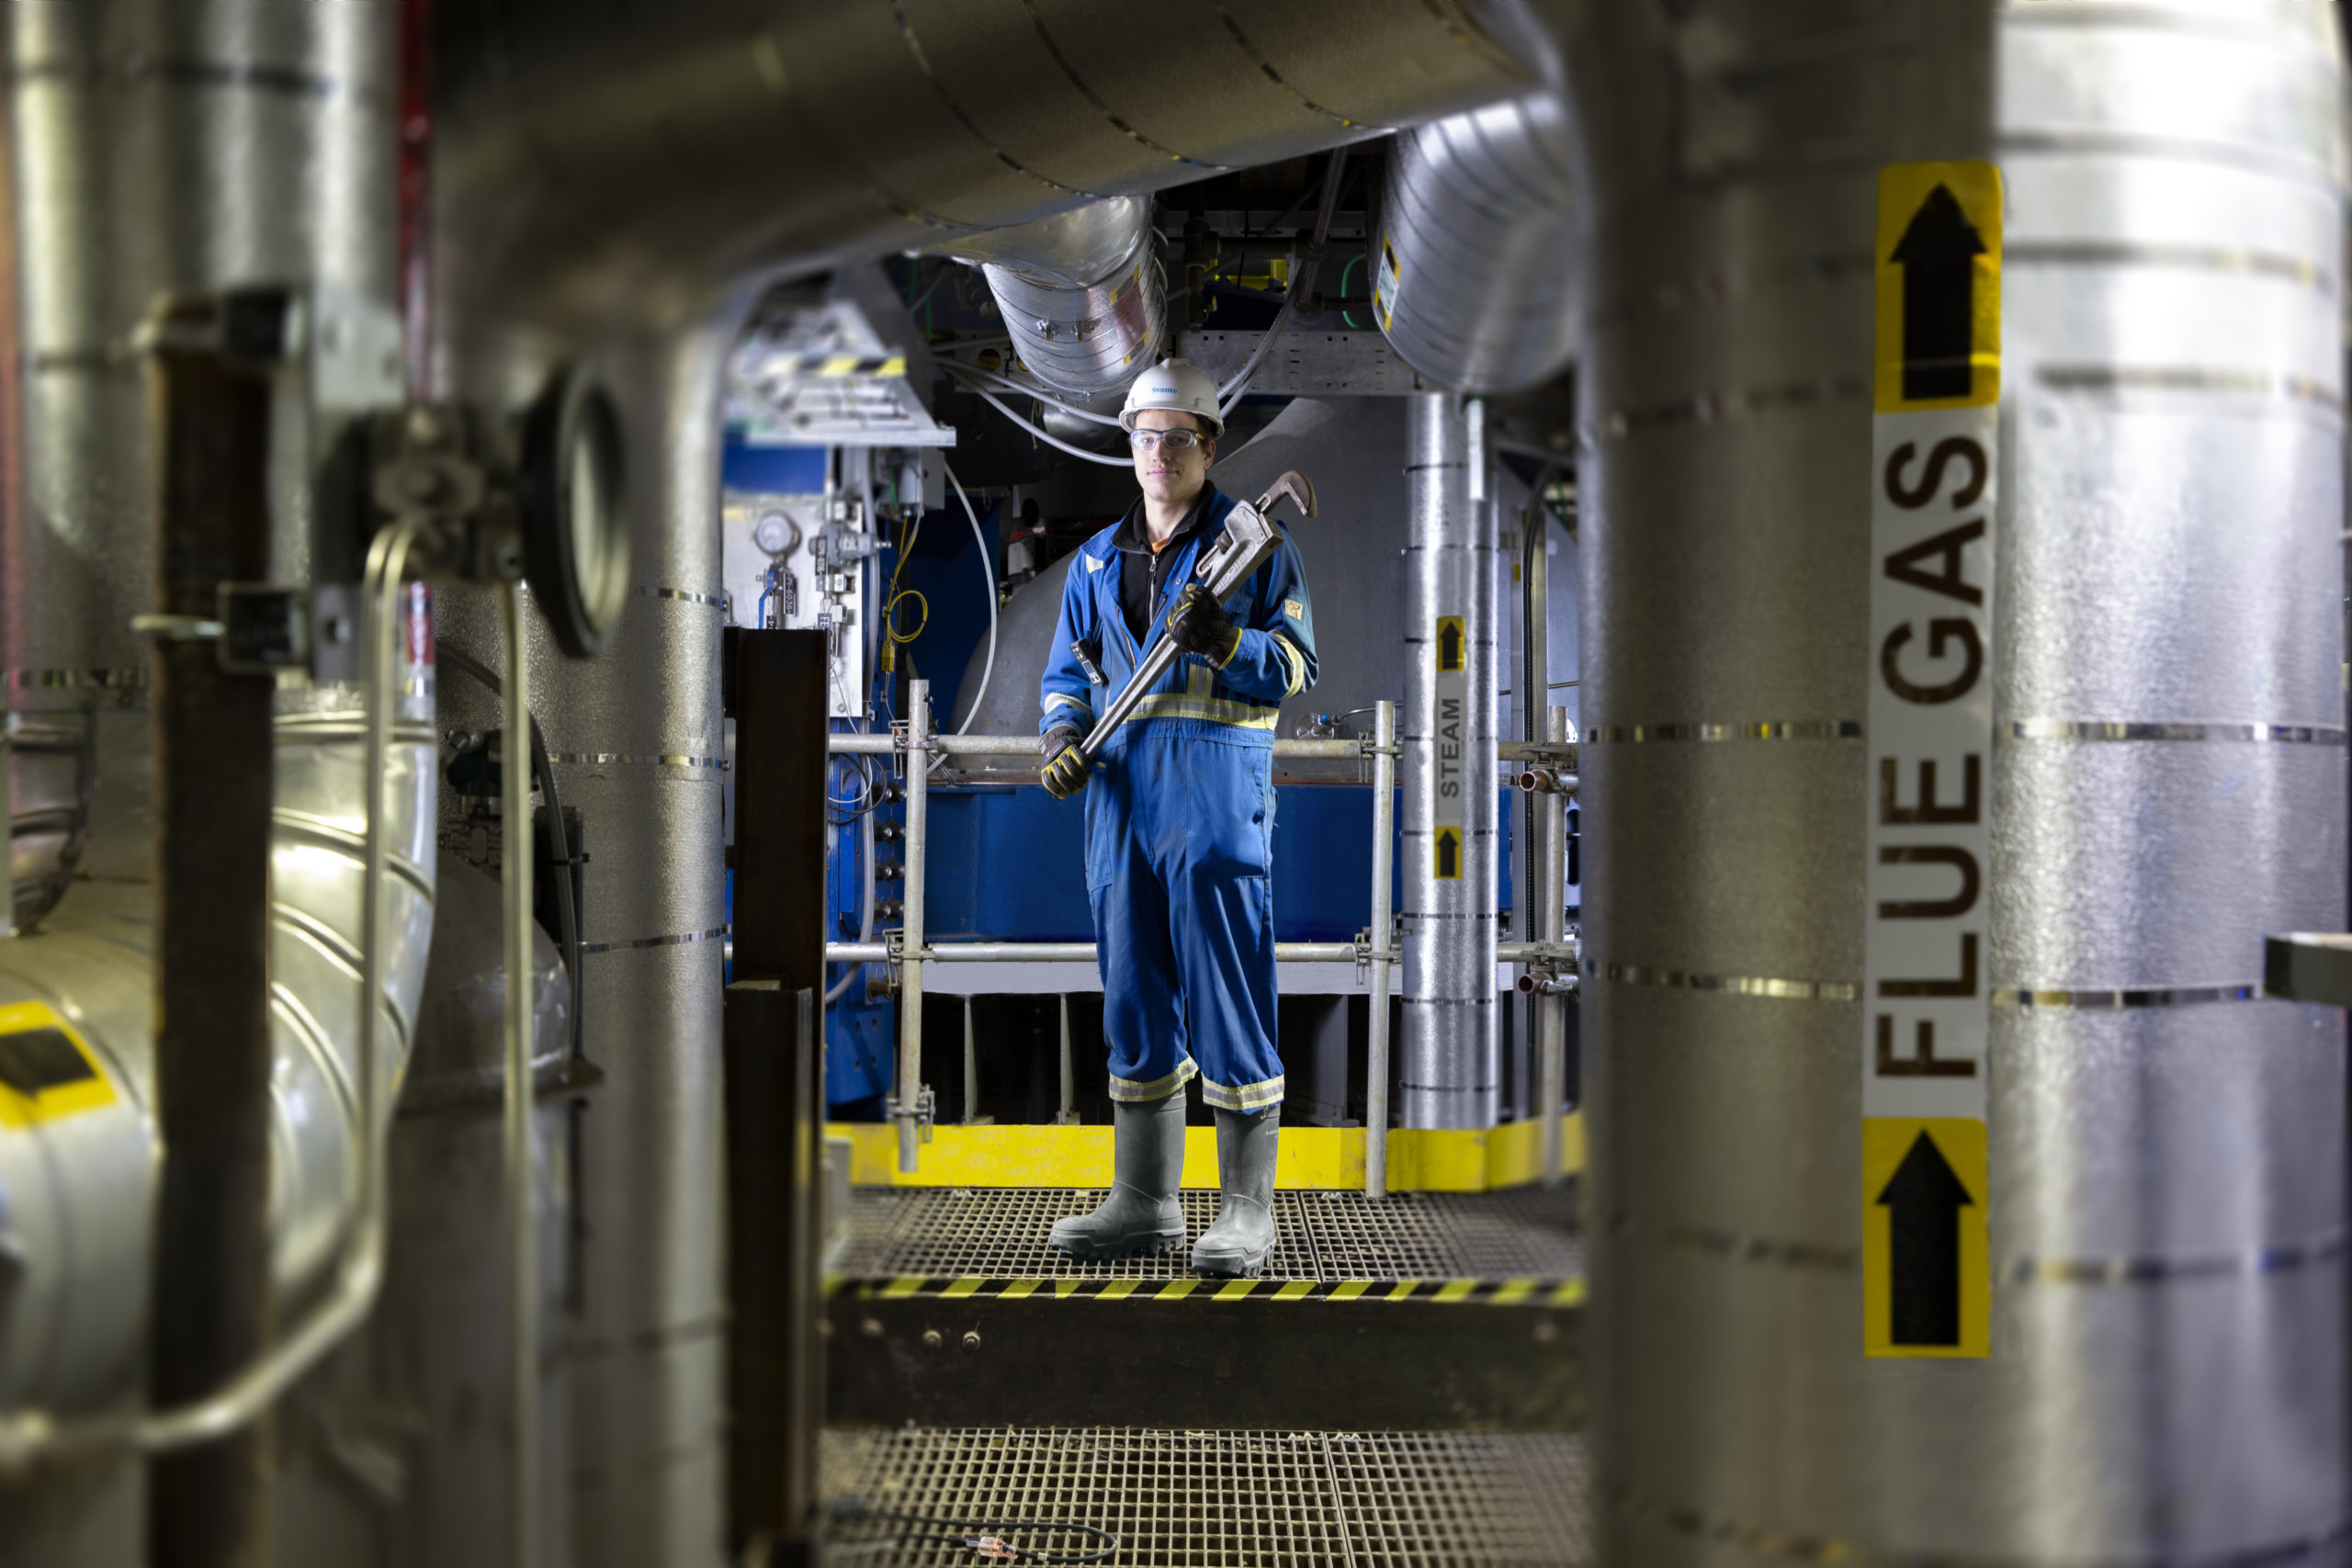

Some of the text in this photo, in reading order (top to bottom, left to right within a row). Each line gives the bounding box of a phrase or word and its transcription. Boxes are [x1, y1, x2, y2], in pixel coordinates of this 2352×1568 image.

[1441, 699, 1460, 798] STEAM
[1876, 436, 1987, 1077] FLUE GAS
